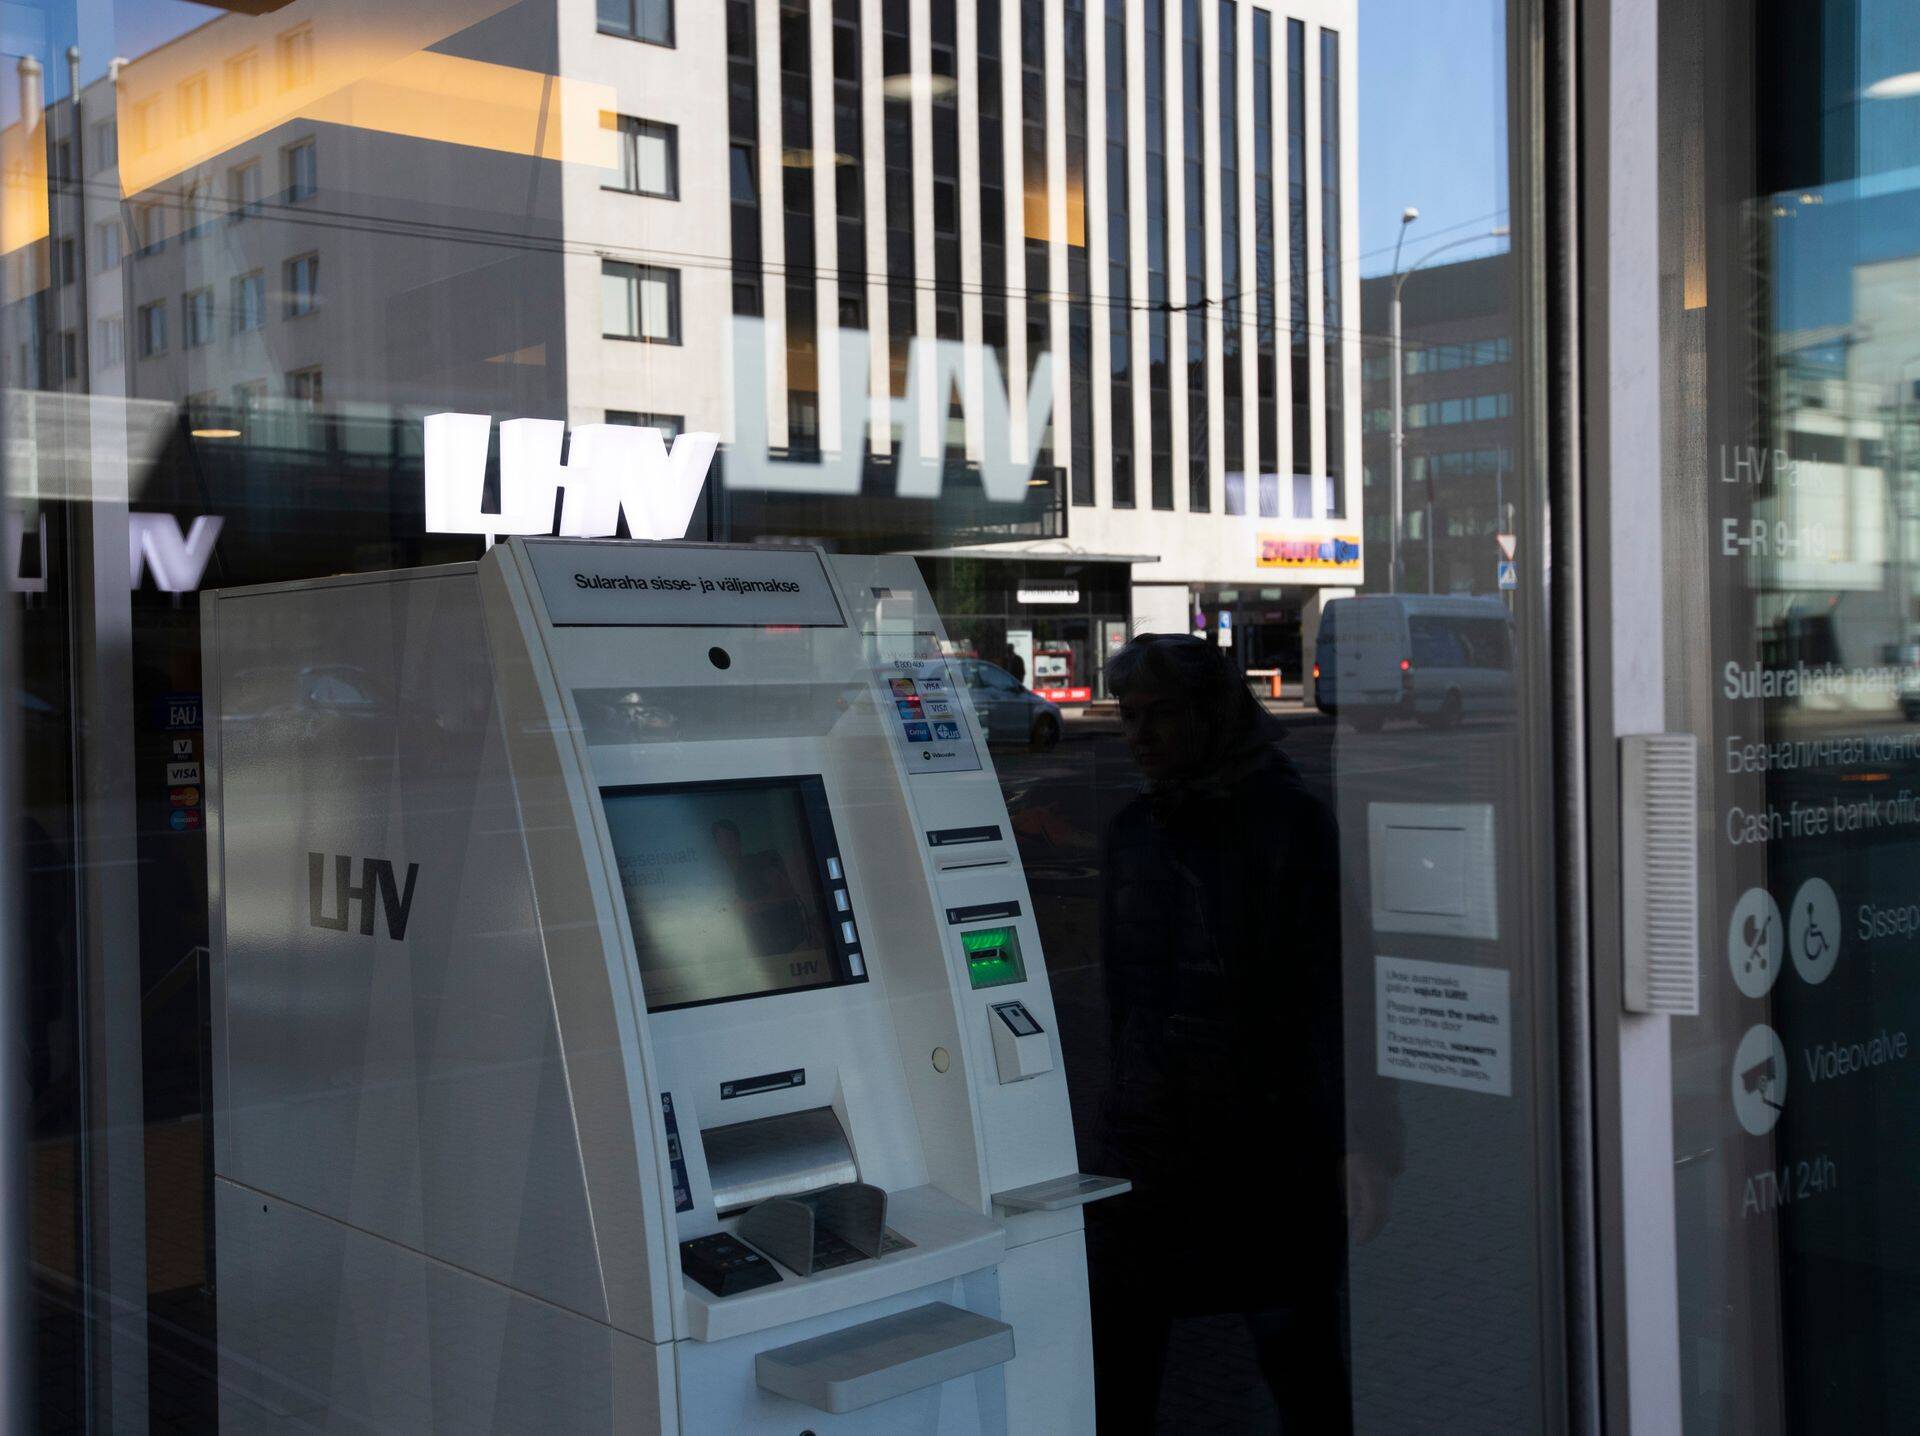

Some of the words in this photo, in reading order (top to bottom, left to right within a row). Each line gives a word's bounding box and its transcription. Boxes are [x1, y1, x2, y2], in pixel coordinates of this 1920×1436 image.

[424, 412, 720, 541] LHV
[1720, 445, 1768, 483] LHV
[574, 573, 649, 590] Sularaha
[651, 575, 697, 591] sisse-
[698, 576, 715, 594] ja
[716, 577, 800, 595] väljamakse
[923, 682, 941, 691] VISA
[1724, 660, 1847, 699] Sularahata
[170, 706, 197, 725] EAU
[931, 704, 948, 713] VISA
[172, 767, 198, 779] VISA
[1726, 735, 1864, 774] Безналичная
[1727, 800, 1829, 845] Cash-free
[1834, 793, 1882, 832] bank
[308, 852, 420, 942] LHV
[789, 960, 819, 977] LHV
[1805, 1028, 1909, 1083] Videovalve
[1741, 1166, 1791, 1220] ATM
[1796, 1155, 1837, 1199] 24h
